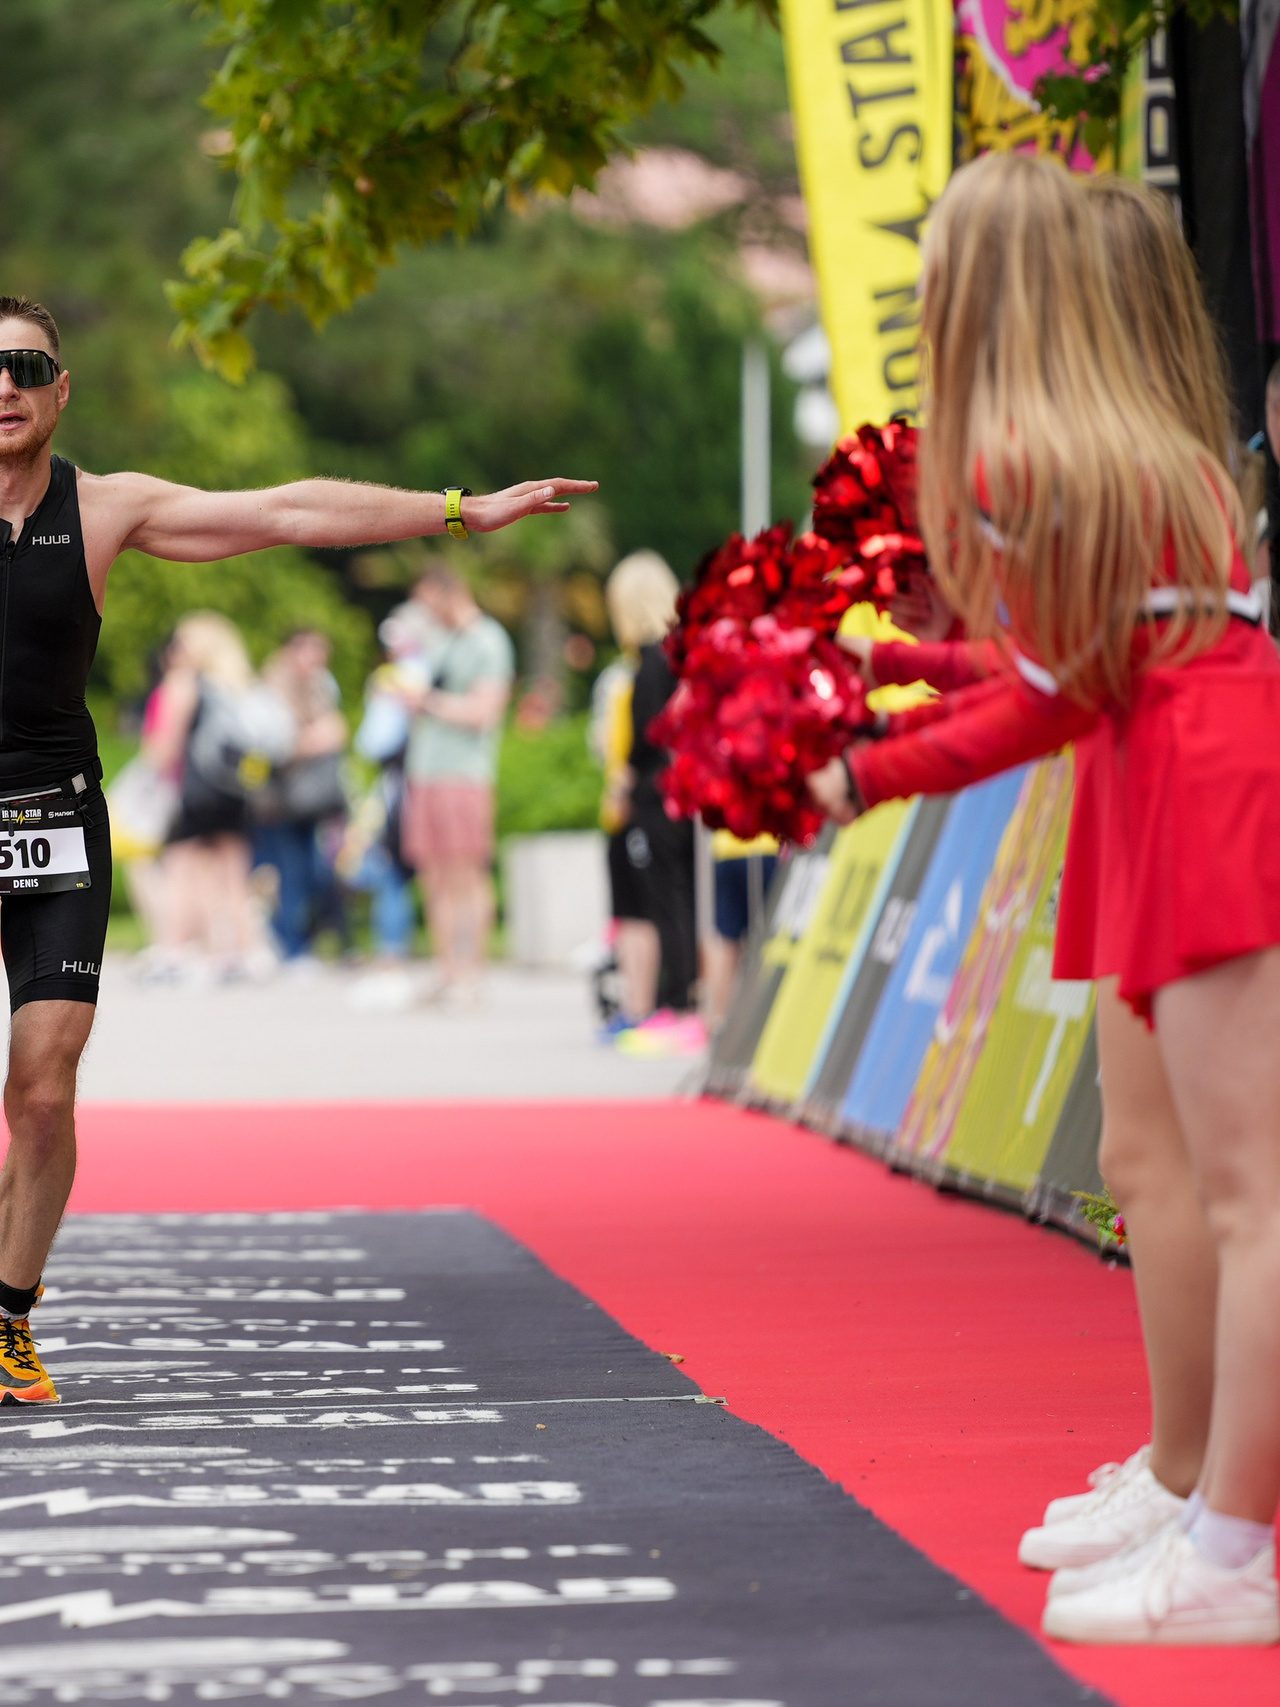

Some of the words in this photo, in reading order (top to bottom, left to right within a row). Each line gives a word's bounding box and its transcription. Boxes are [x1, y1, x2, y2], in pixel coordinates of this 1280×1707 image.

[32, 534, 70, 545] HUUB
[25, 808, 42, 818] STAR
[13, 878, 39, 889] DENIS
[130, 1337, 444, 1349] STAR
[134, 1384, 479, 1399] STAR
[138, 1408, 504, 1426] STAR
[171, 1481, 582, 1501] STAR
[206, 1576, 677, 1606] STAR
